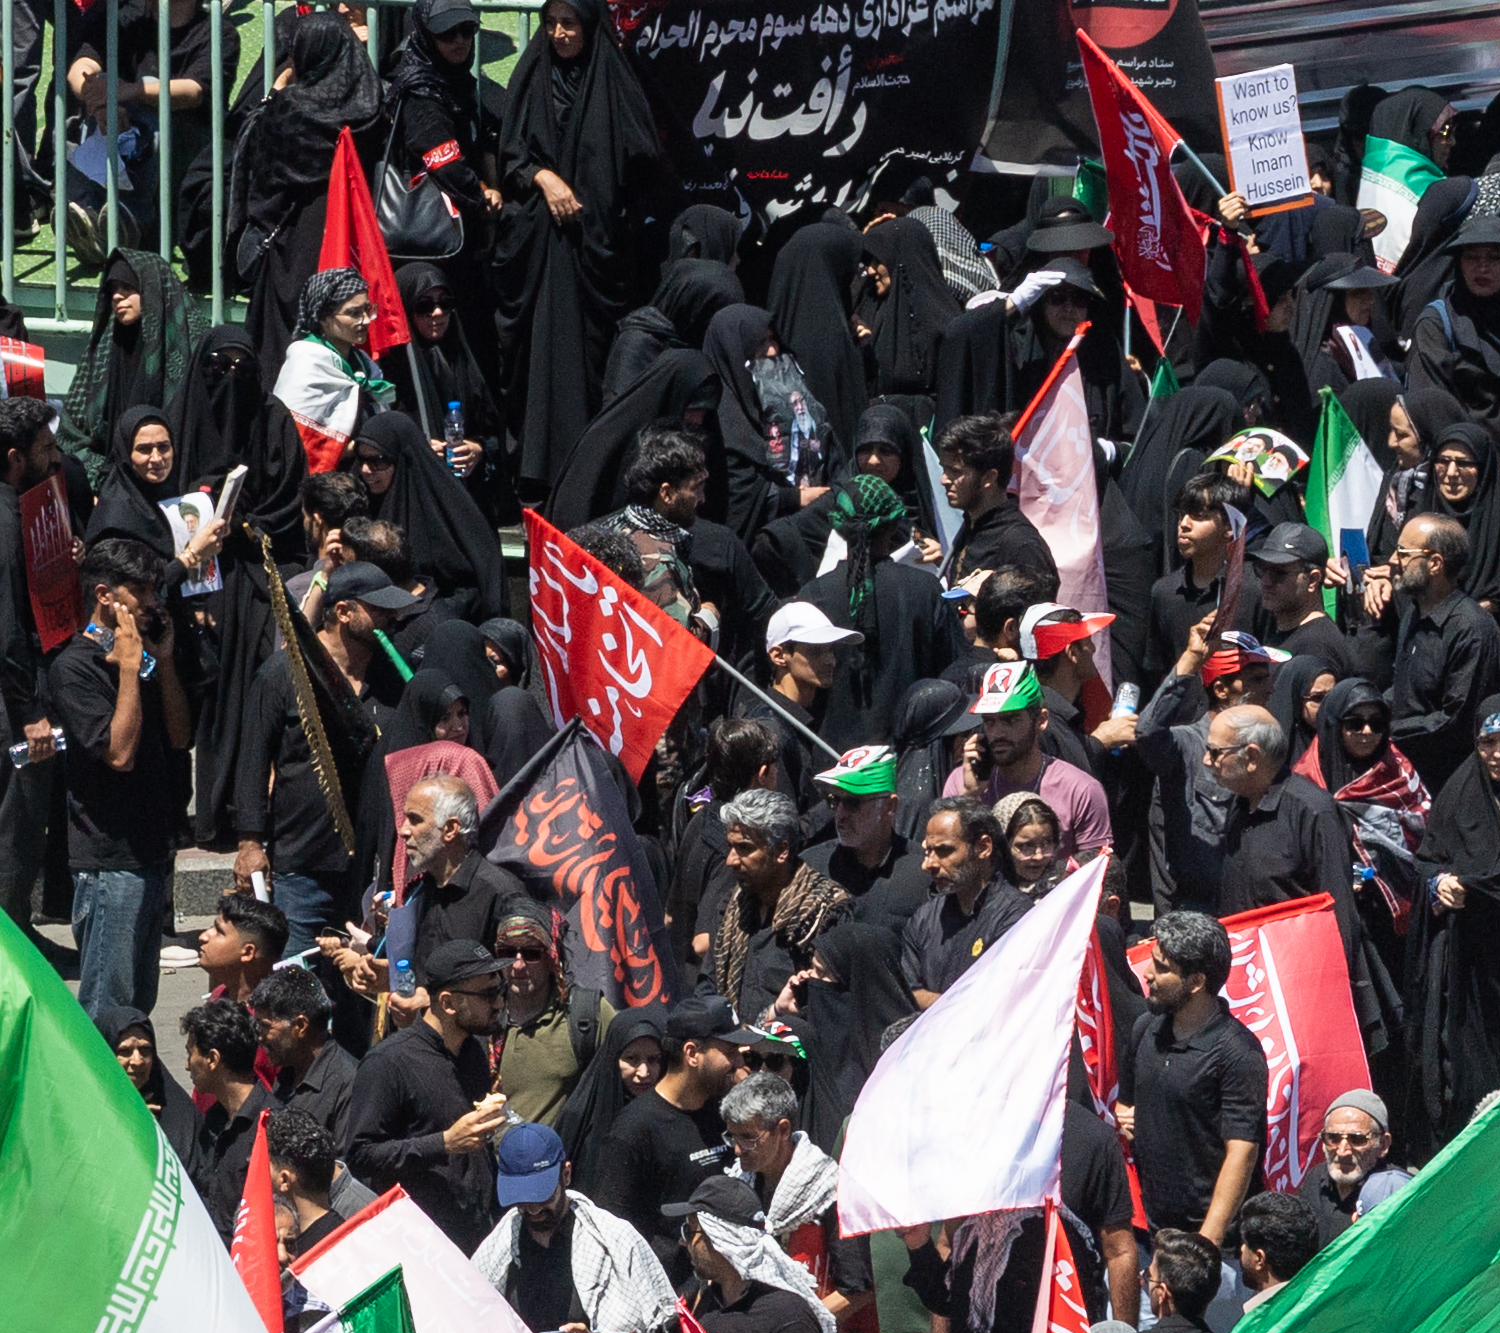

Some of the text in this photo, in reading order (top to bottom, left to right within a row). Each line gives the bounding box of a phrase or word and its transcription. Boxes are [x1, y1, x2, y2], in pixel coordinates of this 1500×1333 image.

[1233, 76, 1289, 100] Want to
[1230, 94, 1297, 126] know us?
[1248, 130, 1289, 153] Know
[1251, 154, 1293, 175] Imam
[1246, 174, 1305, 200] Hussein
